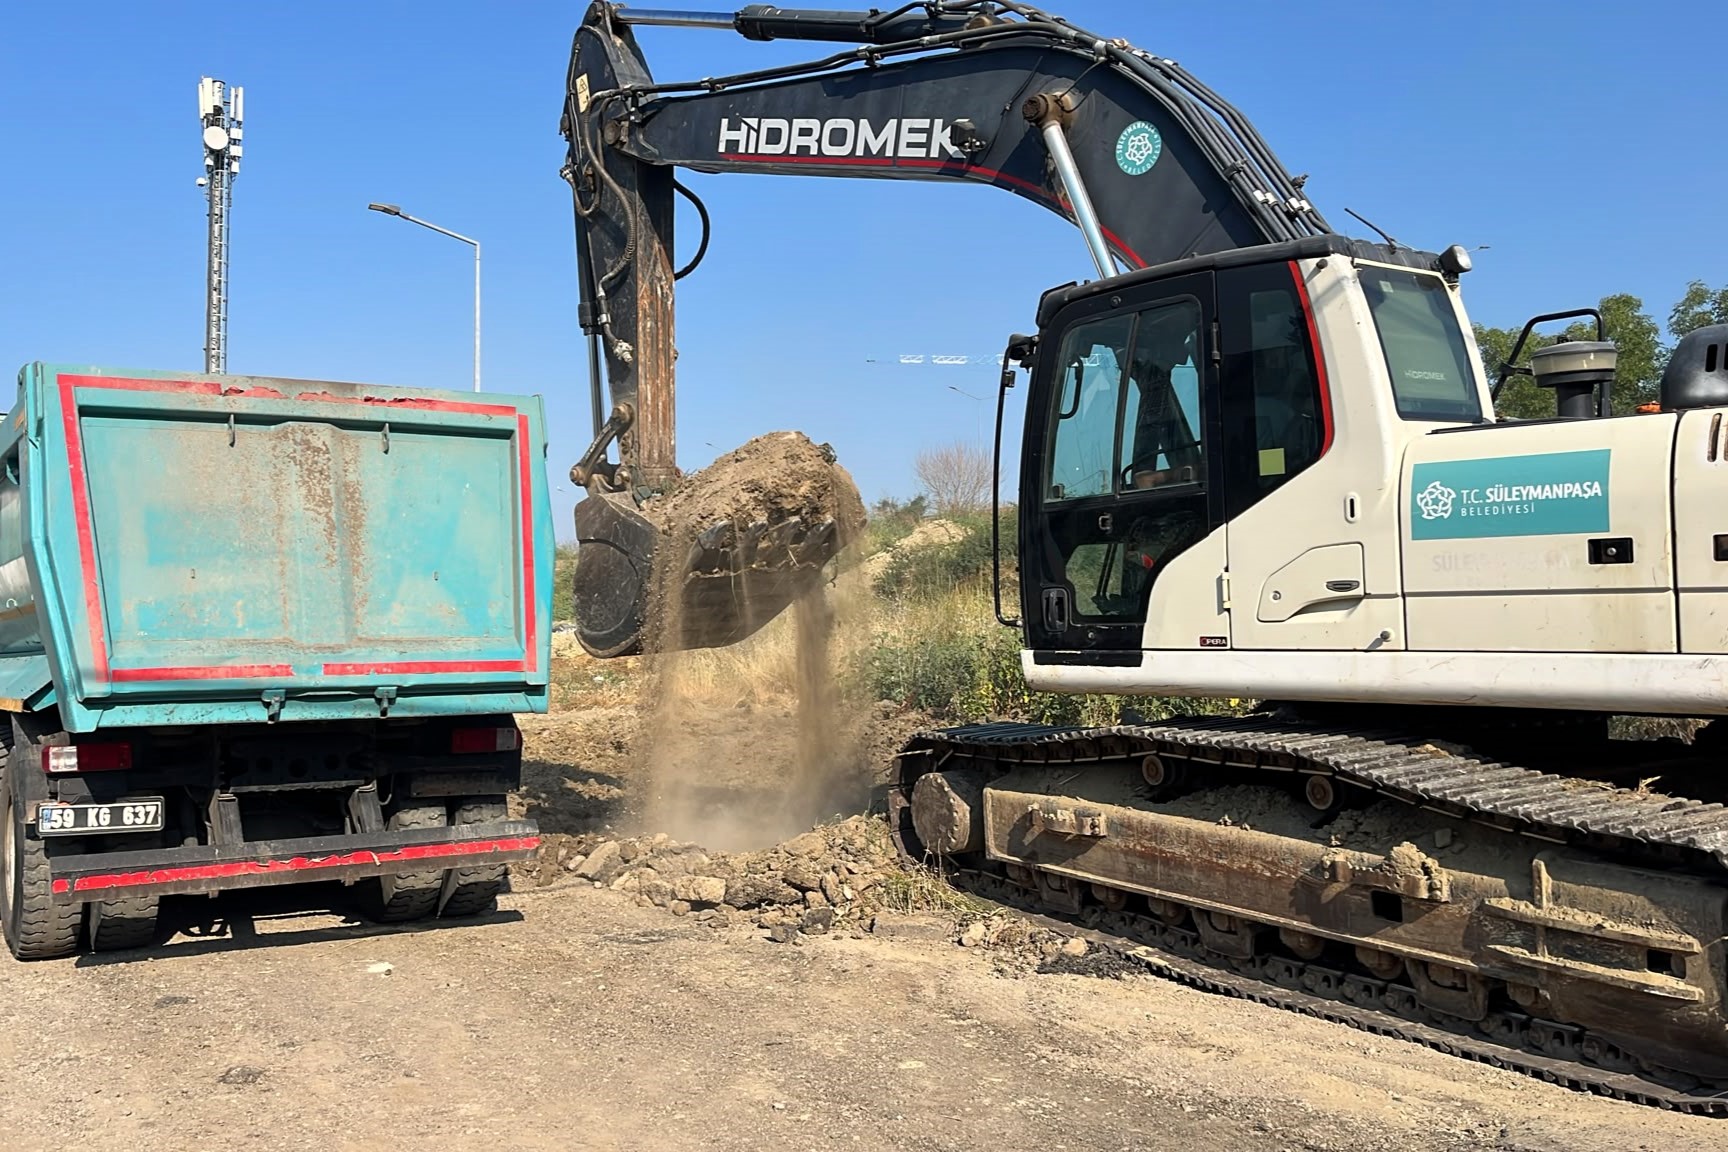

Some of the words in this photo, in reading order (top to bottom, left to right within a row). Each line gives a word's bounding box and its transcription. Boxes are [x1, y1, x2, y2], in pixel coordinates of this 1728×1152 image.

[1461, 489, 1483, 504] T.C.
[1485, 481, 1602, 503] SÜLEYMANPAŞA
[1461, 502, 1535, 517] BELEDİYESİ
[51, 808, 75, 828] 59
[87, 807, 111, 827] KG
[122, 805, 157, 825] 637
